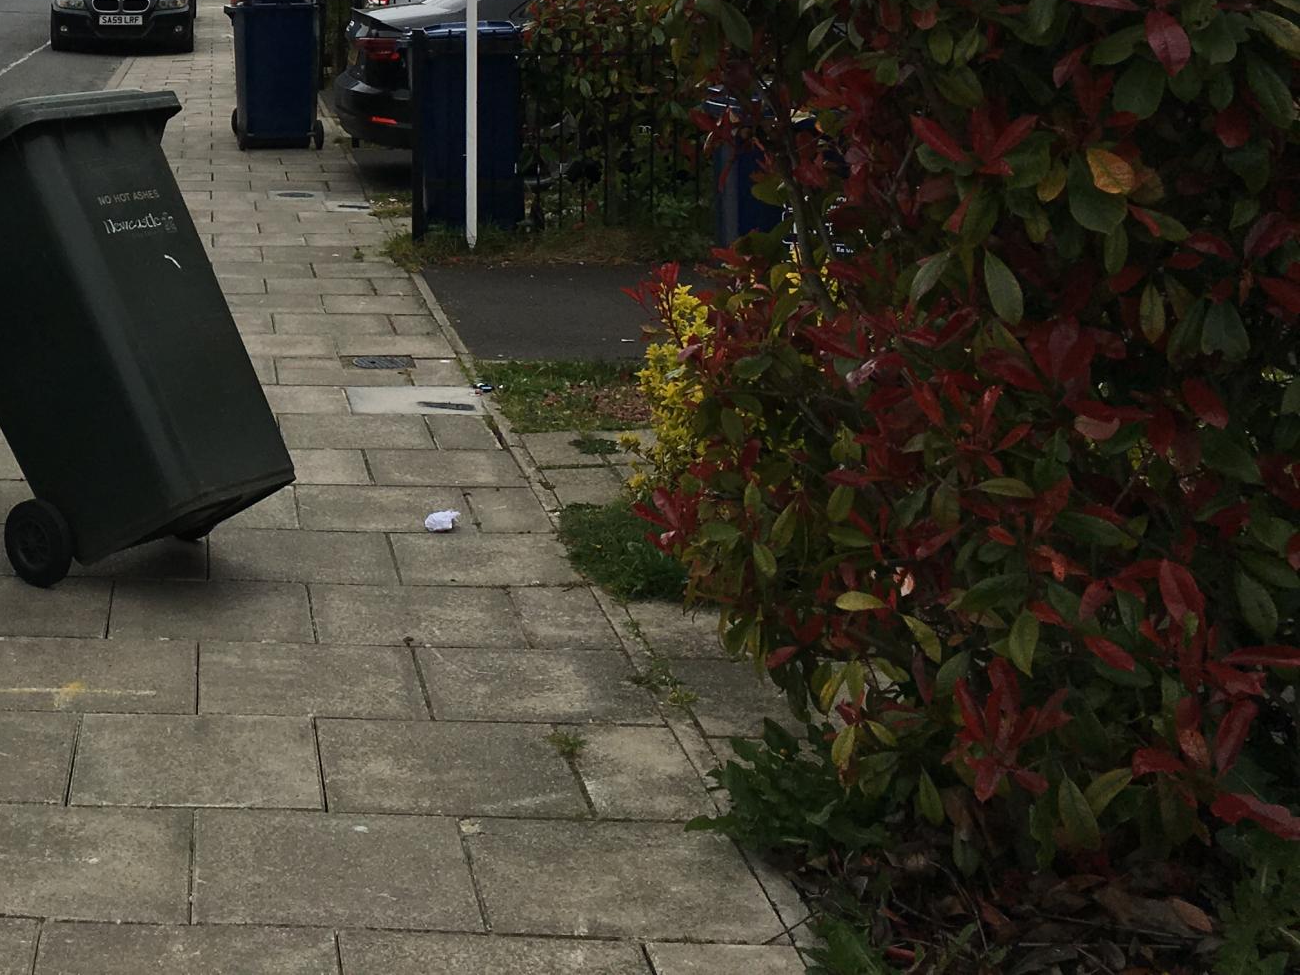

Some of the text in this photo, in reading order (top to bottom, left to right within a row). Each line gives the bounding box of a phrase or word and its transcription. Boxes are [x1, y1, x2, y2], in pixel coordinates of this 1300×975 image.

[102, 16, 140, 24] SA59 LRF
[97, 189, 160, 205] NO HOT ASHES
